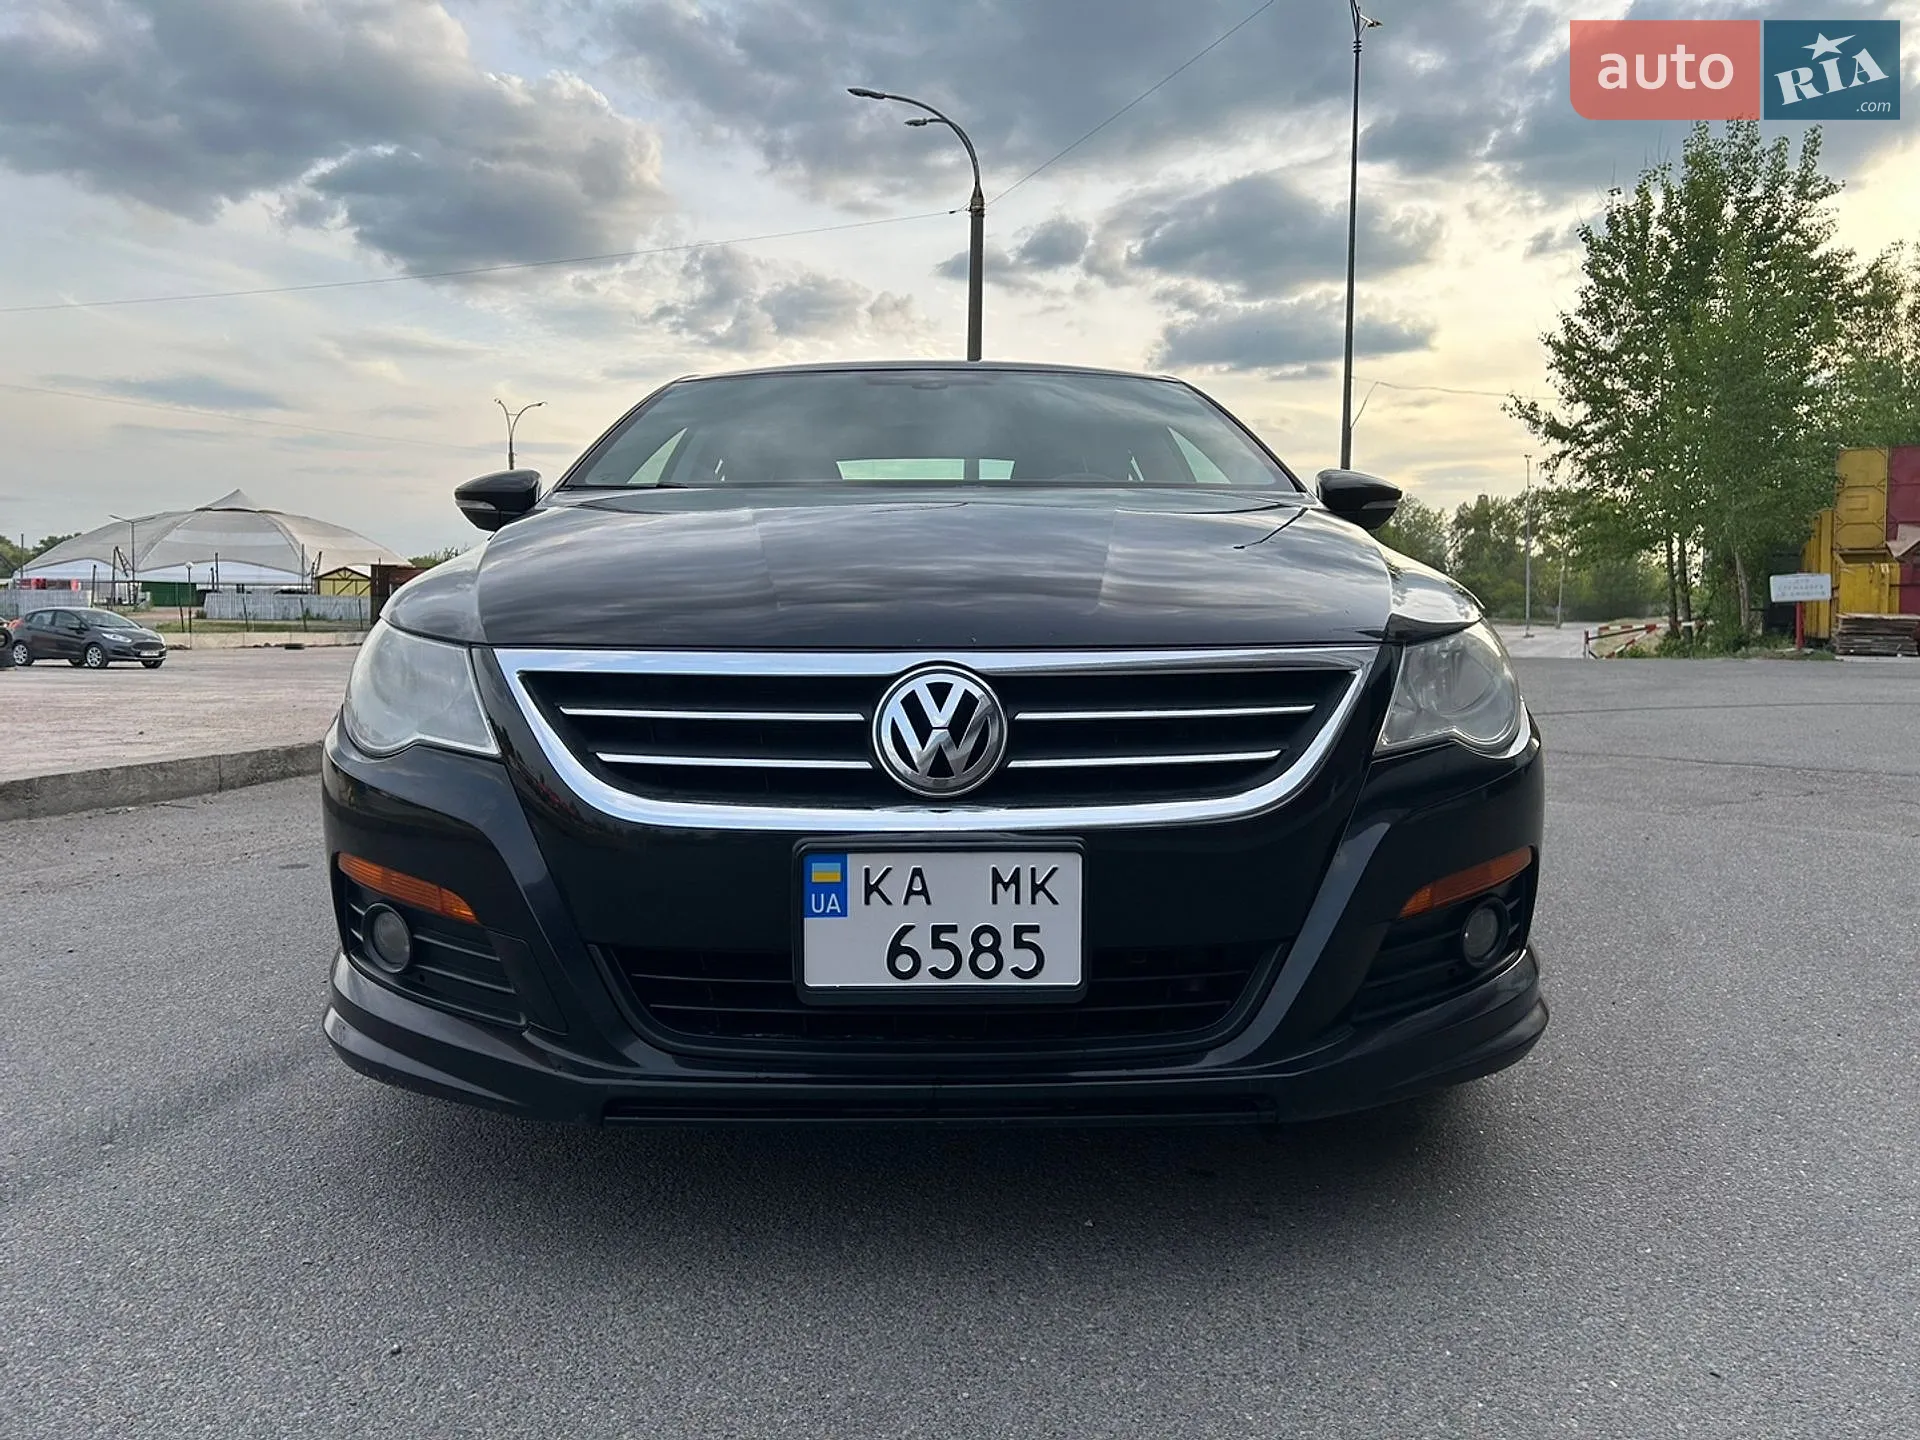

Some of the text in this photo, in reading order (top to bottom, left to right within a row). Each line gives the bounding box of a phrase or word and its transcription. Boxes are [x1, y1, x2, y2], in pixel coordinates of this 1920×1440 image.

[811, 893, 841, 914] UA
[863, 866, 1060, 906] KA MK
[886, 922, 1046, 981] 6585
